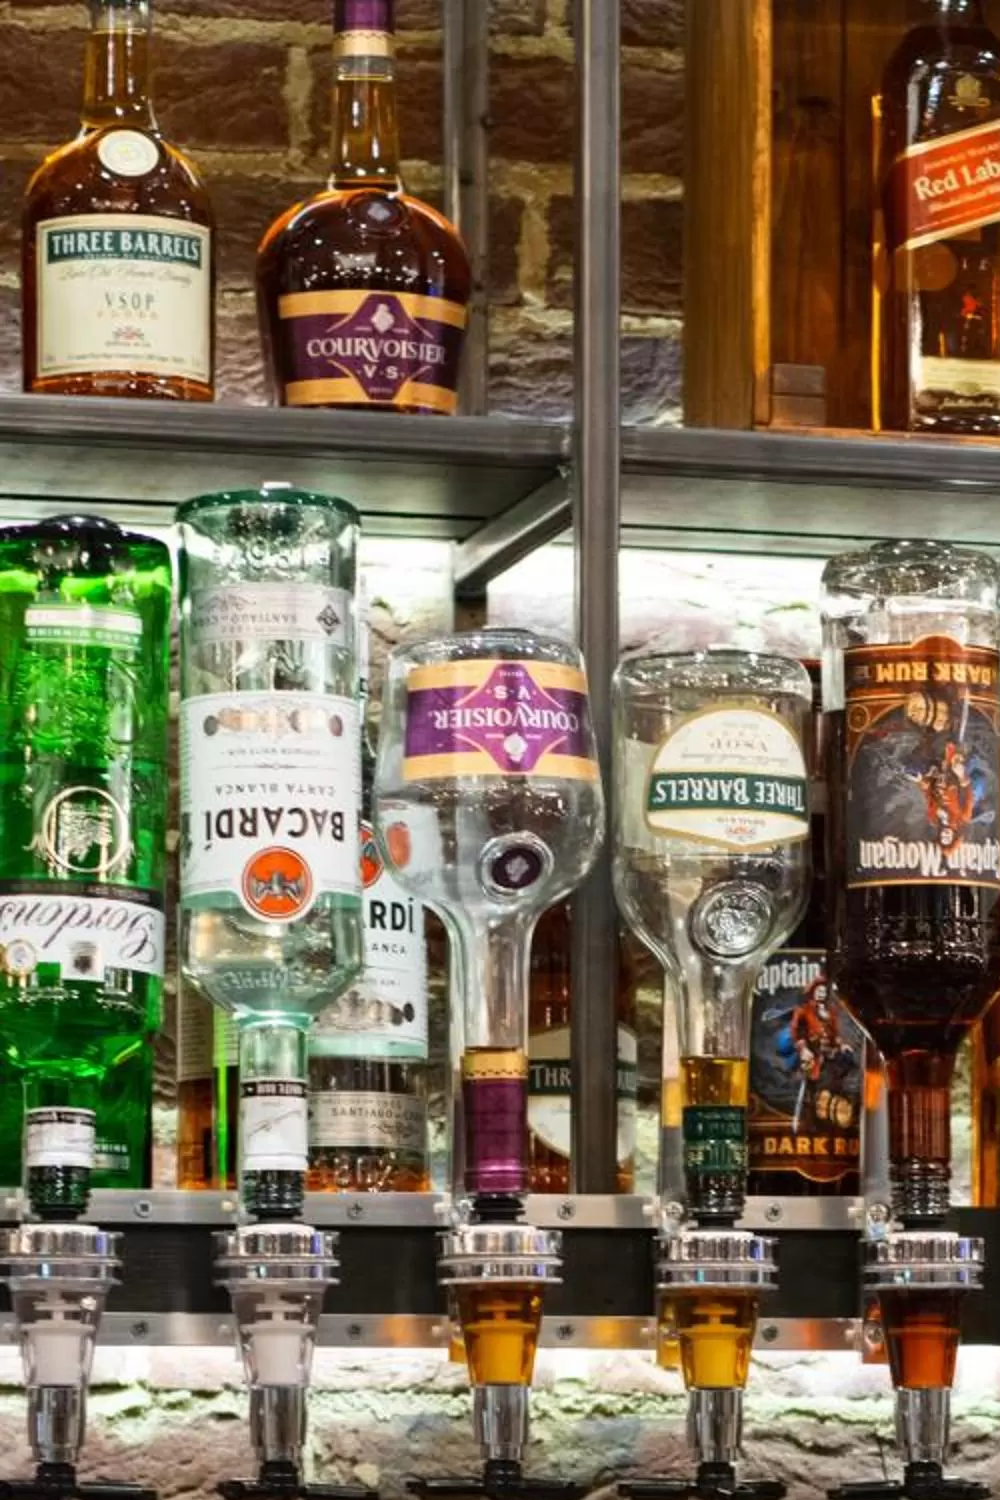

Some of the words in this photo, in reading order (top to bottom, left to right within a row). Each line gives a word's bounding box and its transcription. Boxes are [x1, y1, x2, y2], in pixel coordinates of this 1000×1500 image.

[914, 169, 960, 201] Red
[52, 231, 114, 256] THREE
[120, 231, 199, 261] BARRELS
[307, 337, 446, 365] COURVOISIER
[875, 661, 928, 683] RUM
[933, 662, 992, 686] DARK
[433, 702, 579, 732] COURVOISIER
[655, 777, 750, 805] BARRELS
[753, 781, 805, 812] THREE
[204, 807, 345, 852] BACARDÍ
[859, 836, 948, 877] Morgan
[368, 896, 414, 933] RDÍ
[755, 955, 821, 996] aptain
[530, 1063, 572, 1089] THR
[763, 1137, 829, 1155] DARK
[834, 1137, 860, 1155] RU
